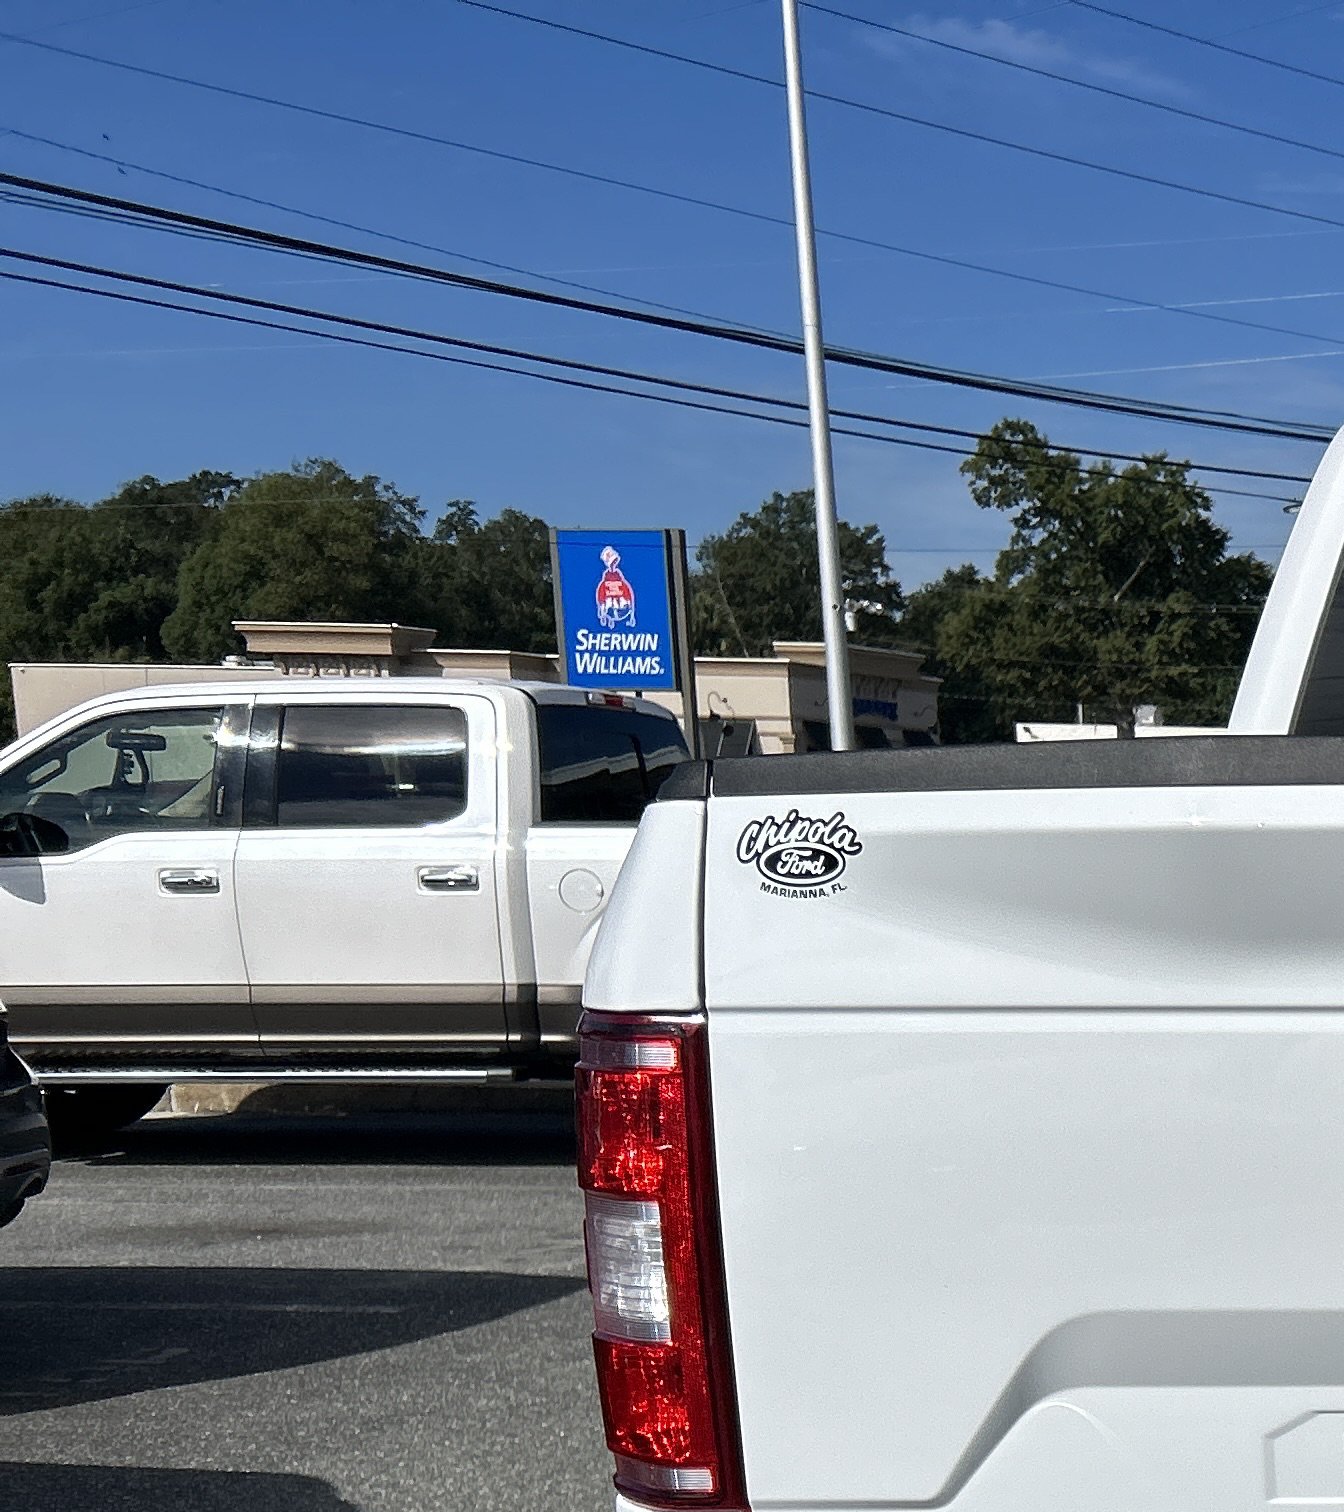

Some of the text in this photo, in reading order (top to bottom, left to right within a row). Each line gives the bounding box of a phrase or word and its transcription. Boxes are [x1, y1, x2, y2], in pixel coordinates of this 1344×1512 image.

[576, 629, 659, 651] SHERWIN
[736, 808, 863, 864] Chipola
[776, 849, 826, 875] Ford
